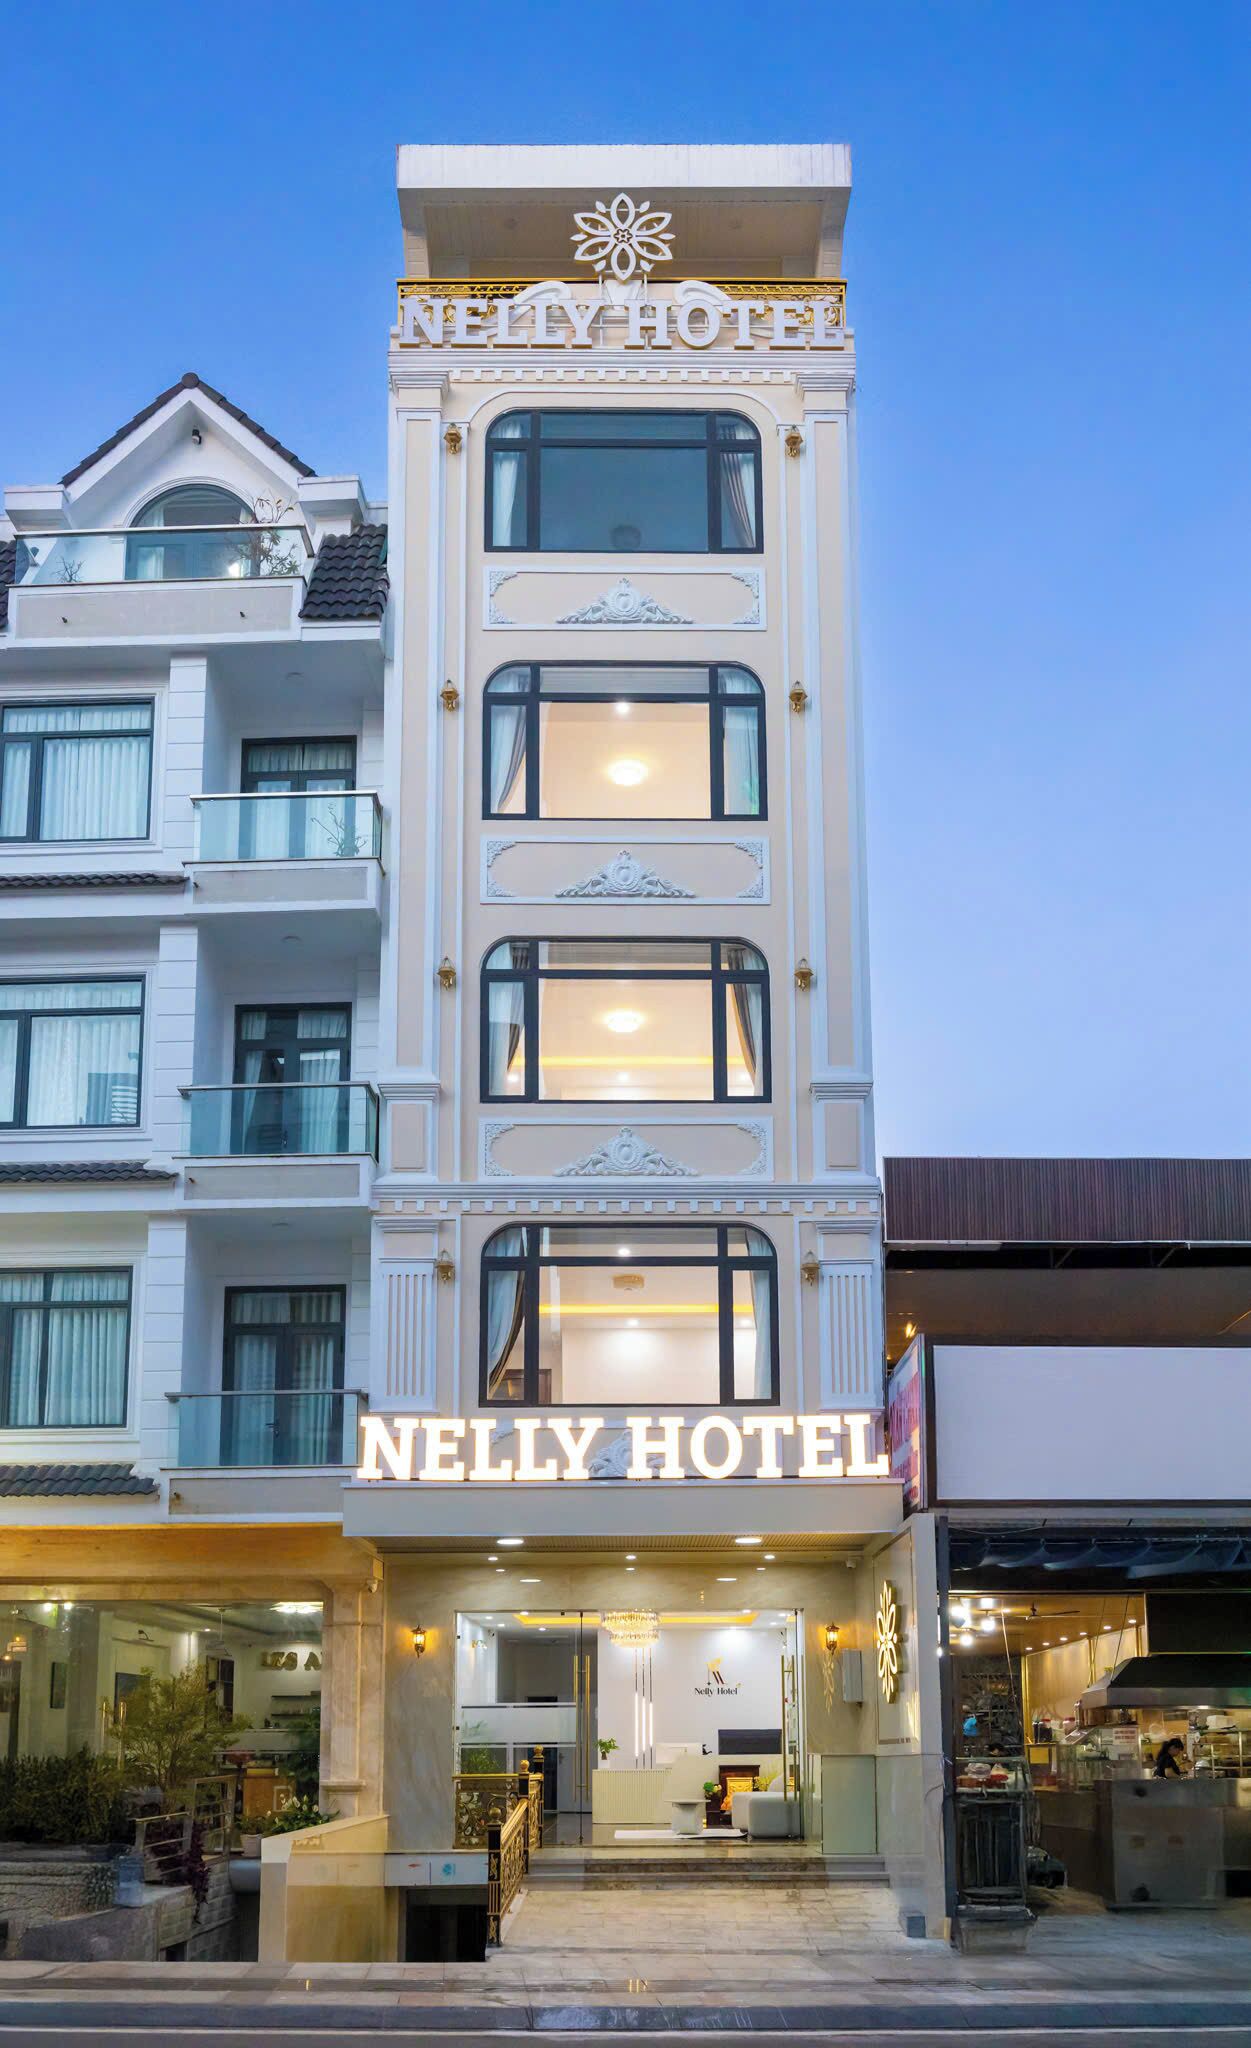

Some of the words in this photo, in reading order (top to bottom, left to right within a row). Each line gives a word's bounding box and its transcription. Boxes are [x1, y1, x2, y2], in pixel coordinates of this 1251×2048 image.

[399, 299, 607, 348] NELLY
[624, 299, 845, 350] HOTEL
[357, 1416, 604, 1482] NELLY
[627, 1414, 890, 1480] HOTEL
[694, 1687, 714, 1697] Nelly
[717, 1687, 738, 1695] Hotel
